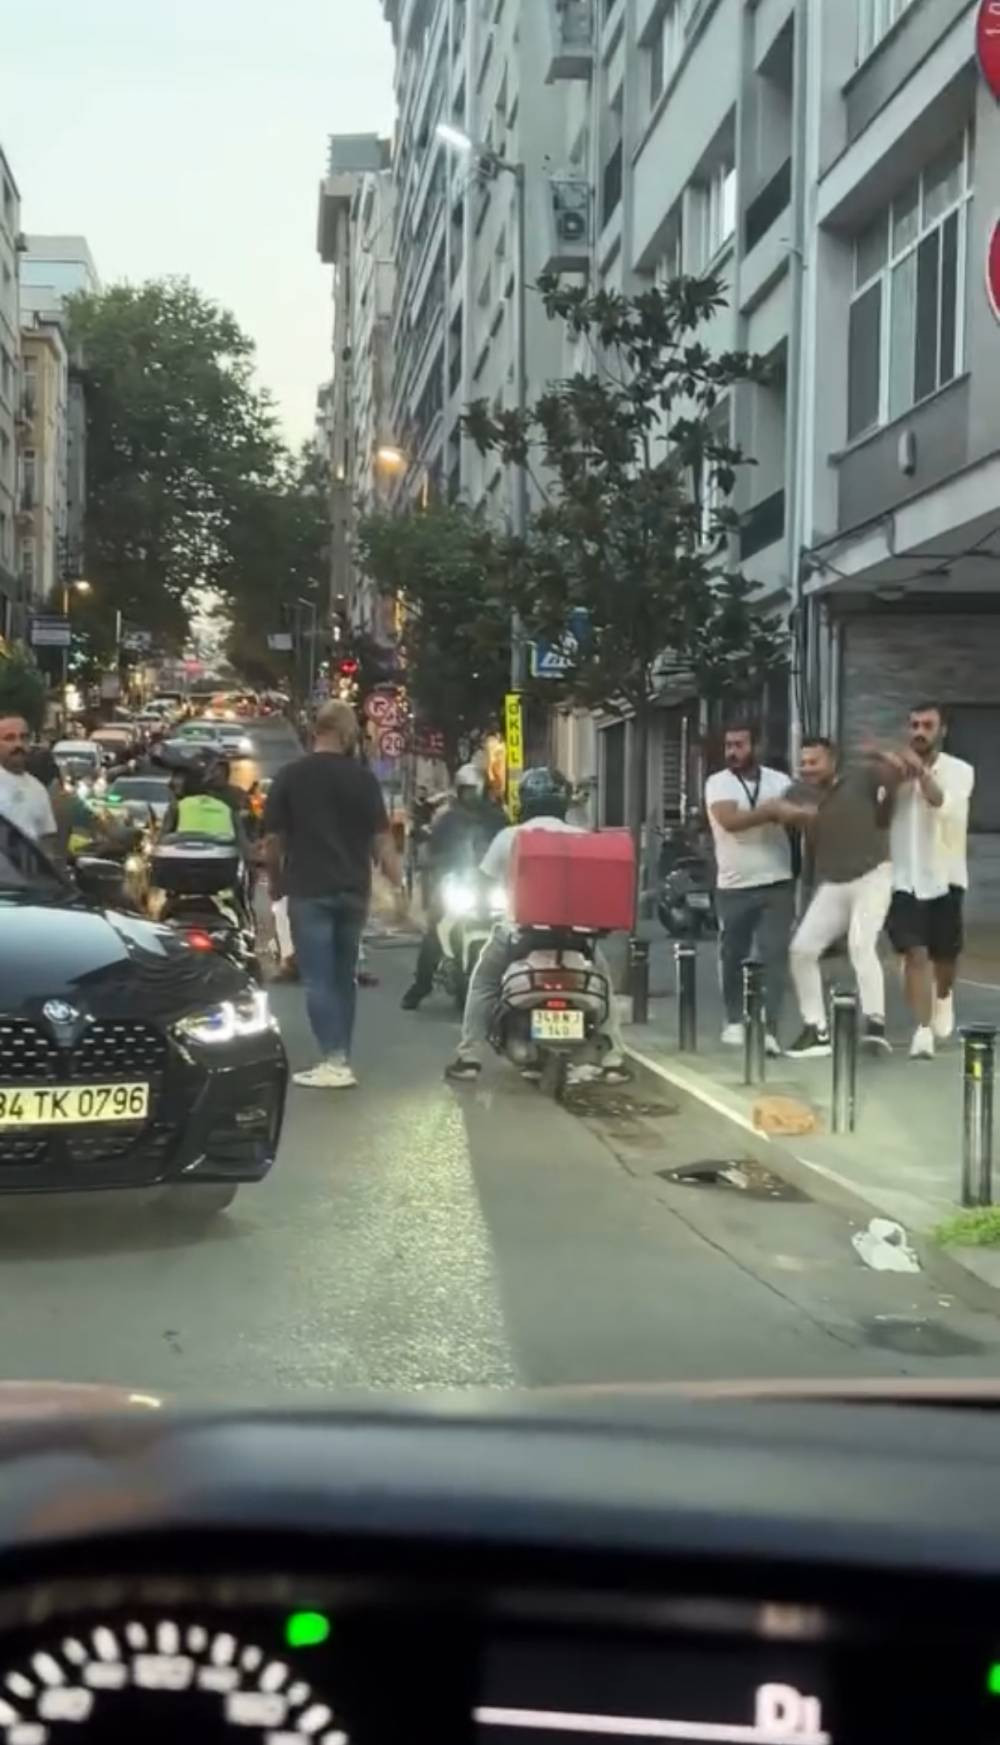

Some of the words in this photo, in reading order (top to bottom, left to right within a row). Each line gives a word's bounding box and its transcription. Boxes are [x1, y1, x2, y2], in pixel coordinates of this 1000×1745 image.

[508, 703, 519, 762] OKUL
[34, 1090, 72, 1118] TK
[78, 1086, 144, 1117] 0796
